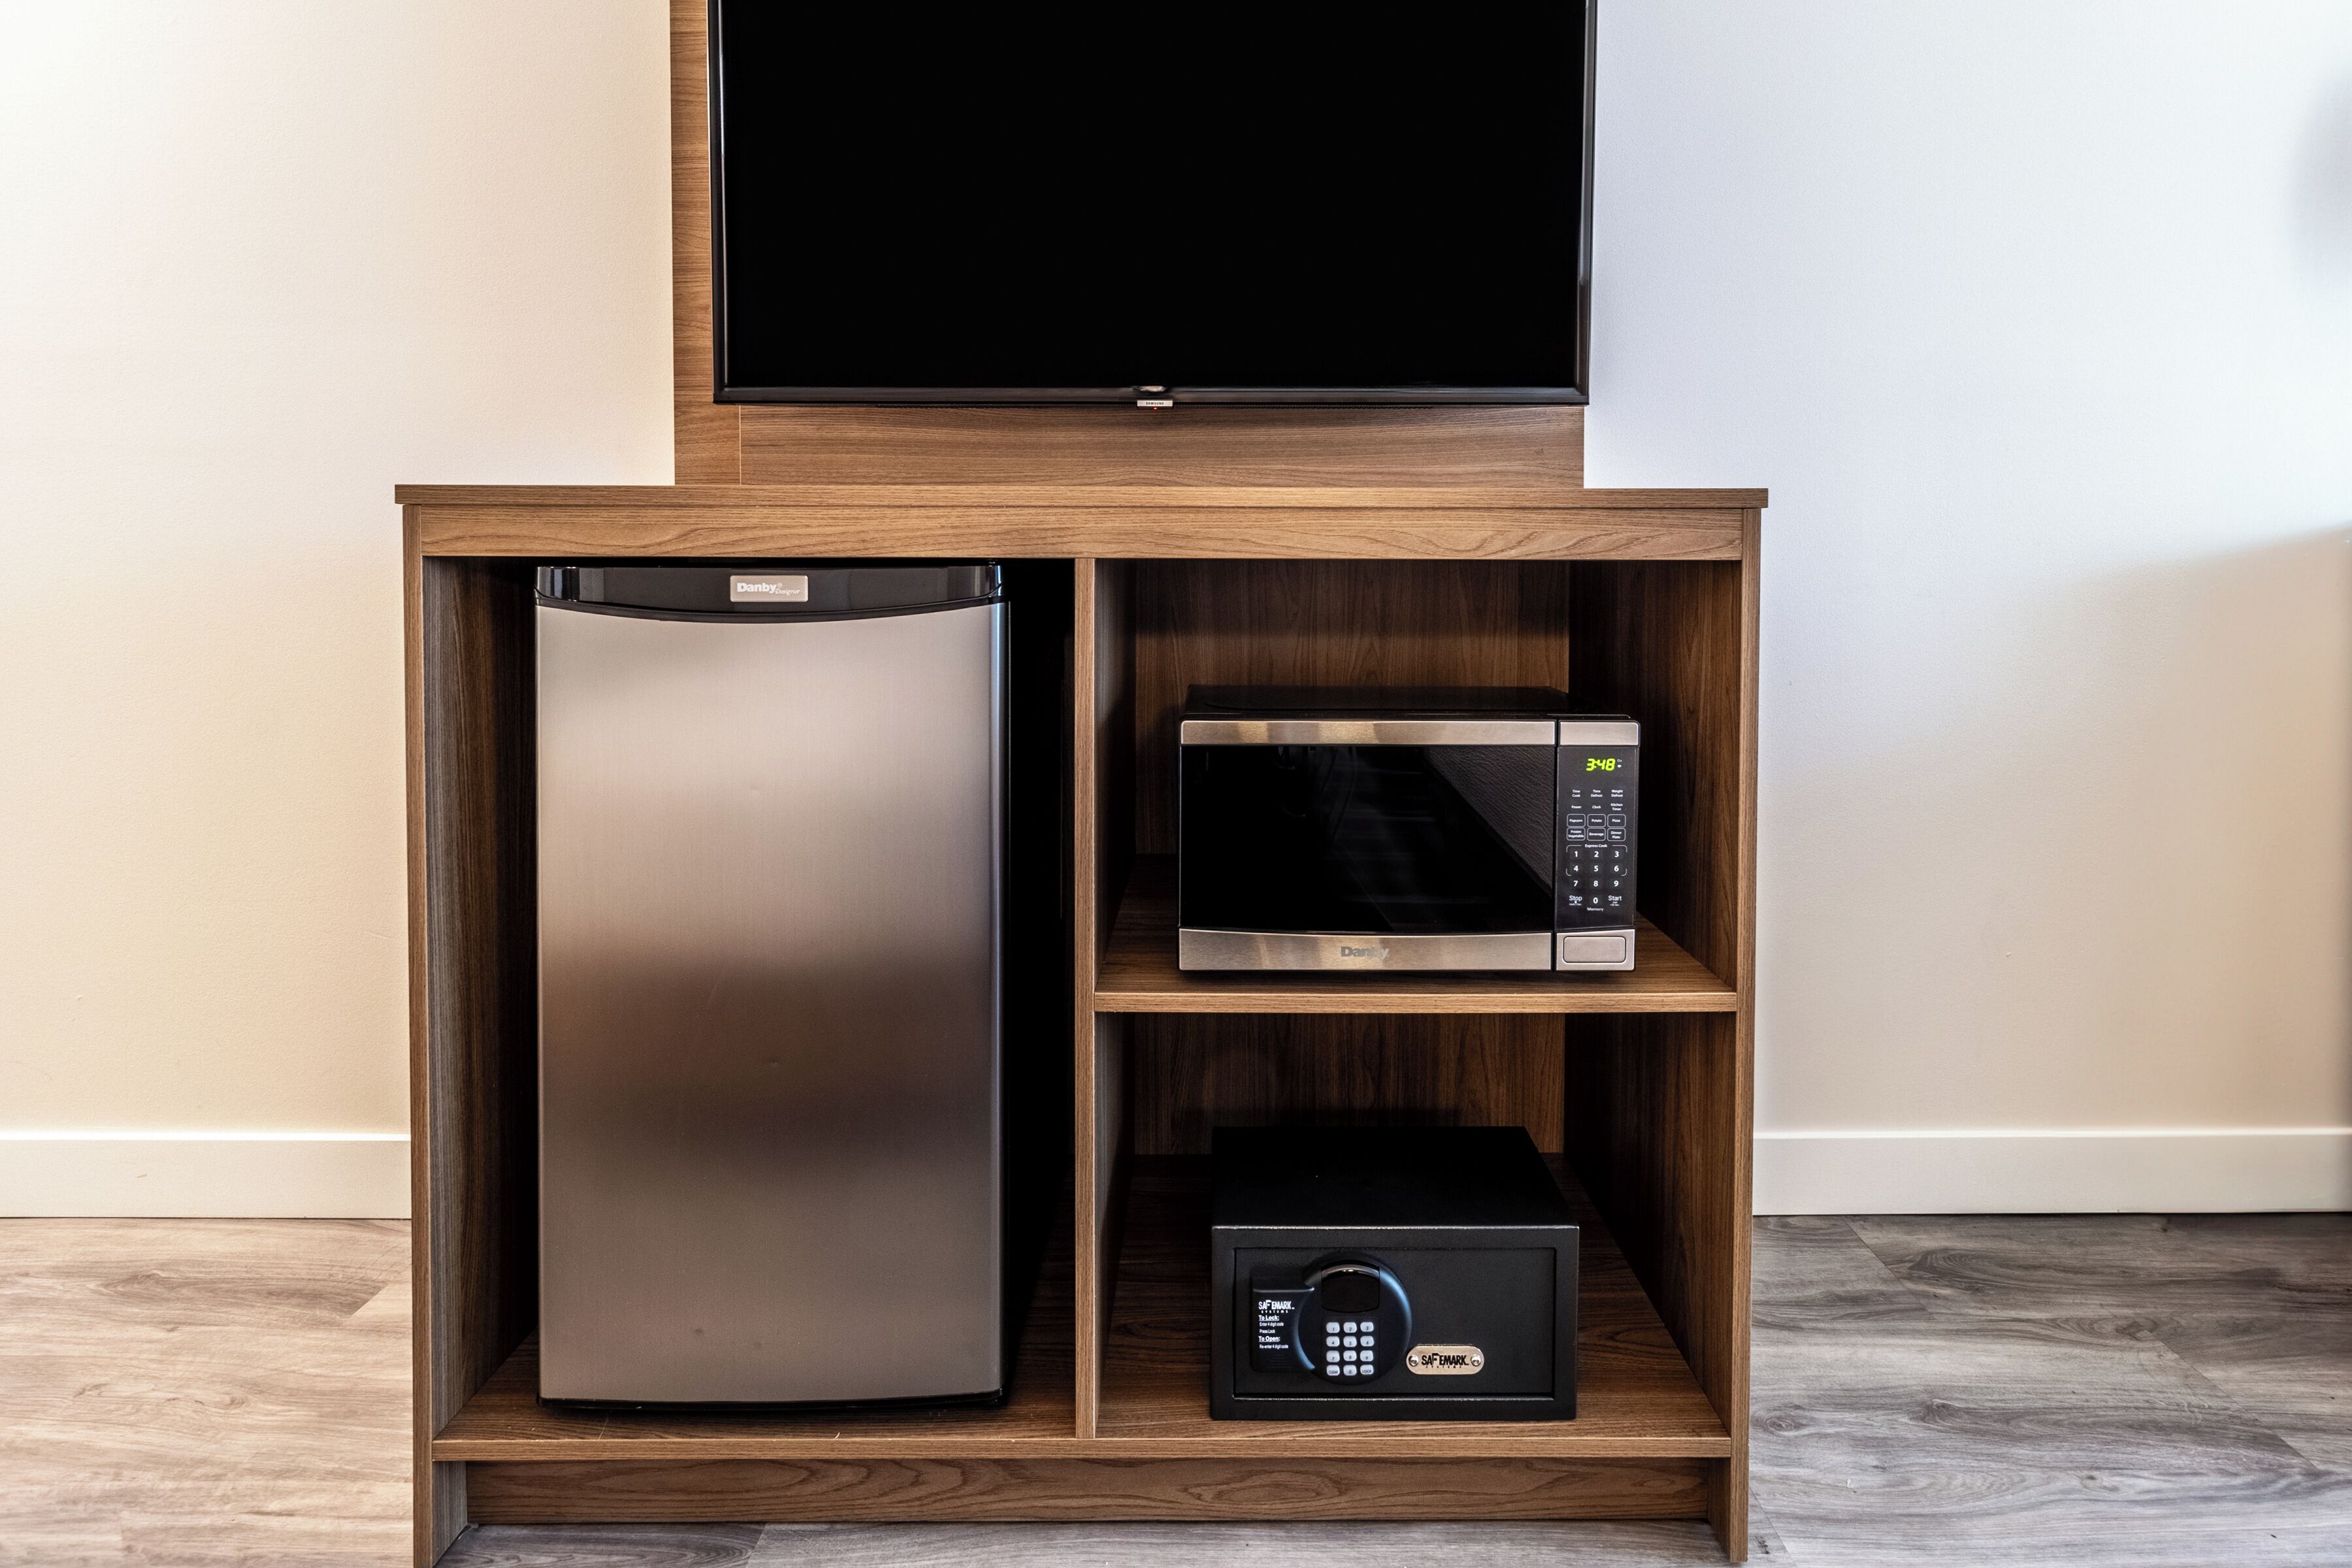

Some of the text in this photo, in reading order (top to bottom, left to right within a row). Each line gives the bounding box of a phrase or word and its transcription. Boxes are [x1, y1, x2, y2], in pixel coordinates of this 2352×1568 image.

[737, 583, 777, 593] Danby
[1586, 758, 1616, 771] 3:48
[1258, 1299, 1292, 1310] SAFEMARK
[1421, 1352, 1467, 1365] SAFEMARK
